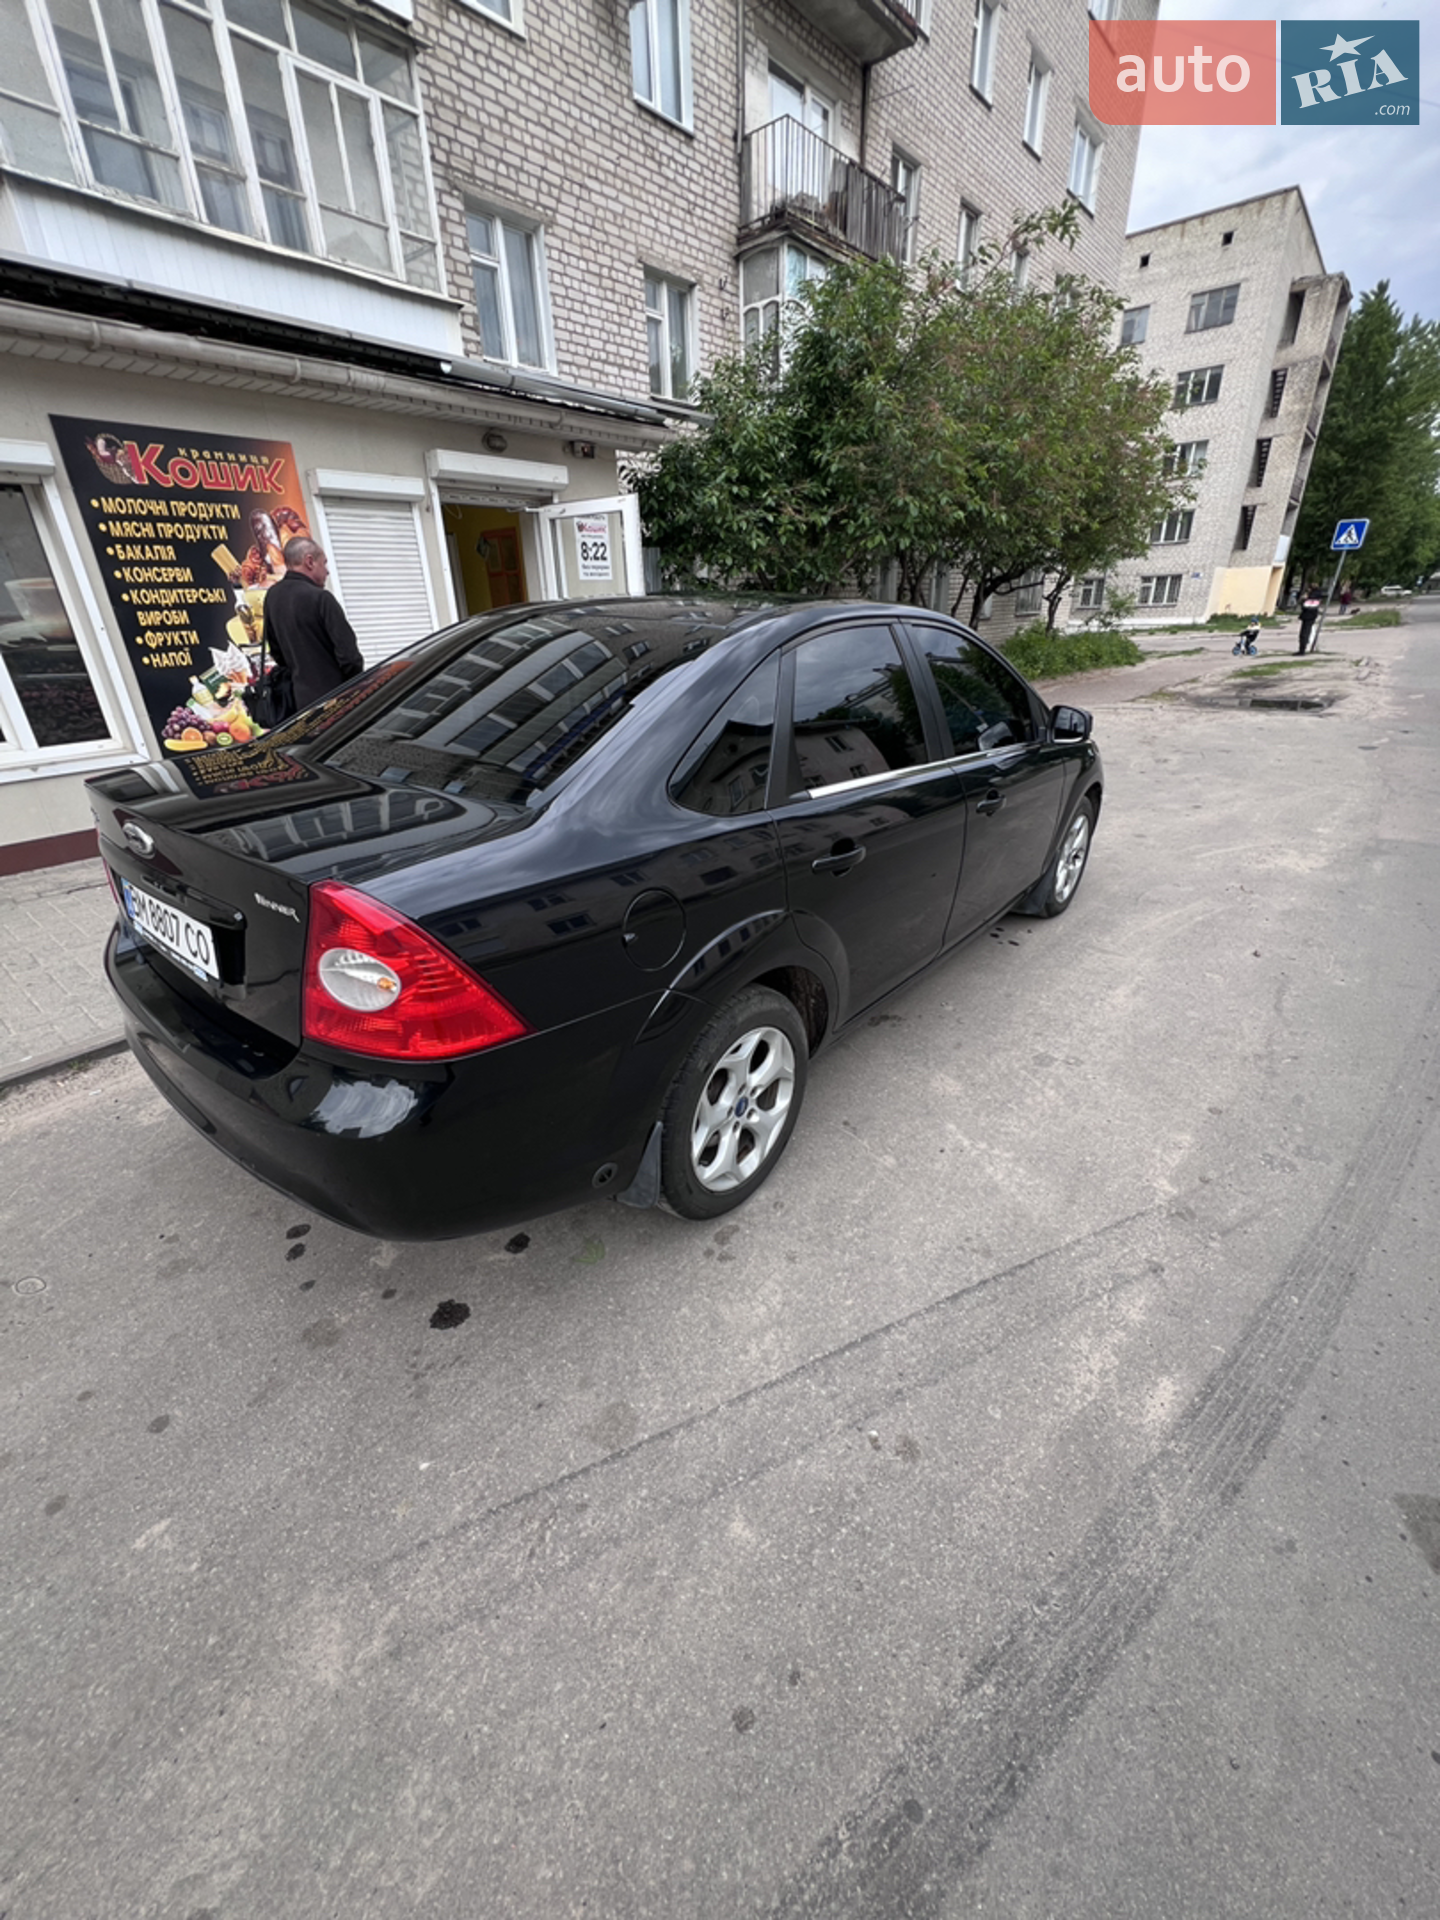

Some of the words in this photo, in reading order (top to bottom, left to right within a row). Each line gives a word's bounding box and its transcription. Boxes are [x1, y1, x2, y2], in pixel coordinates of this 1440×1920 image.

[101, 497, 169, 516] МОЛОЧНІ
[170, 501, 241, 521] ПРОДУКТИ
[108, 520, 155, 538] МЯСНІ
[156, 522, 228, 542] ПРОДУКТИ
[114, 544, 177, 561] БАКАЛІЯ
[122, 566, 194, 582] КОНСЕРВИ
[129, 587, 227, 607] КОНДИТЕРСЬКІ
[136, 609, 190, 627] ВИРОБИ
[144, 629, 200, 649] ФРУКТИ
[149, 647, 193, 667] НАПОЇ
[184, 922, 210, 966] CO
